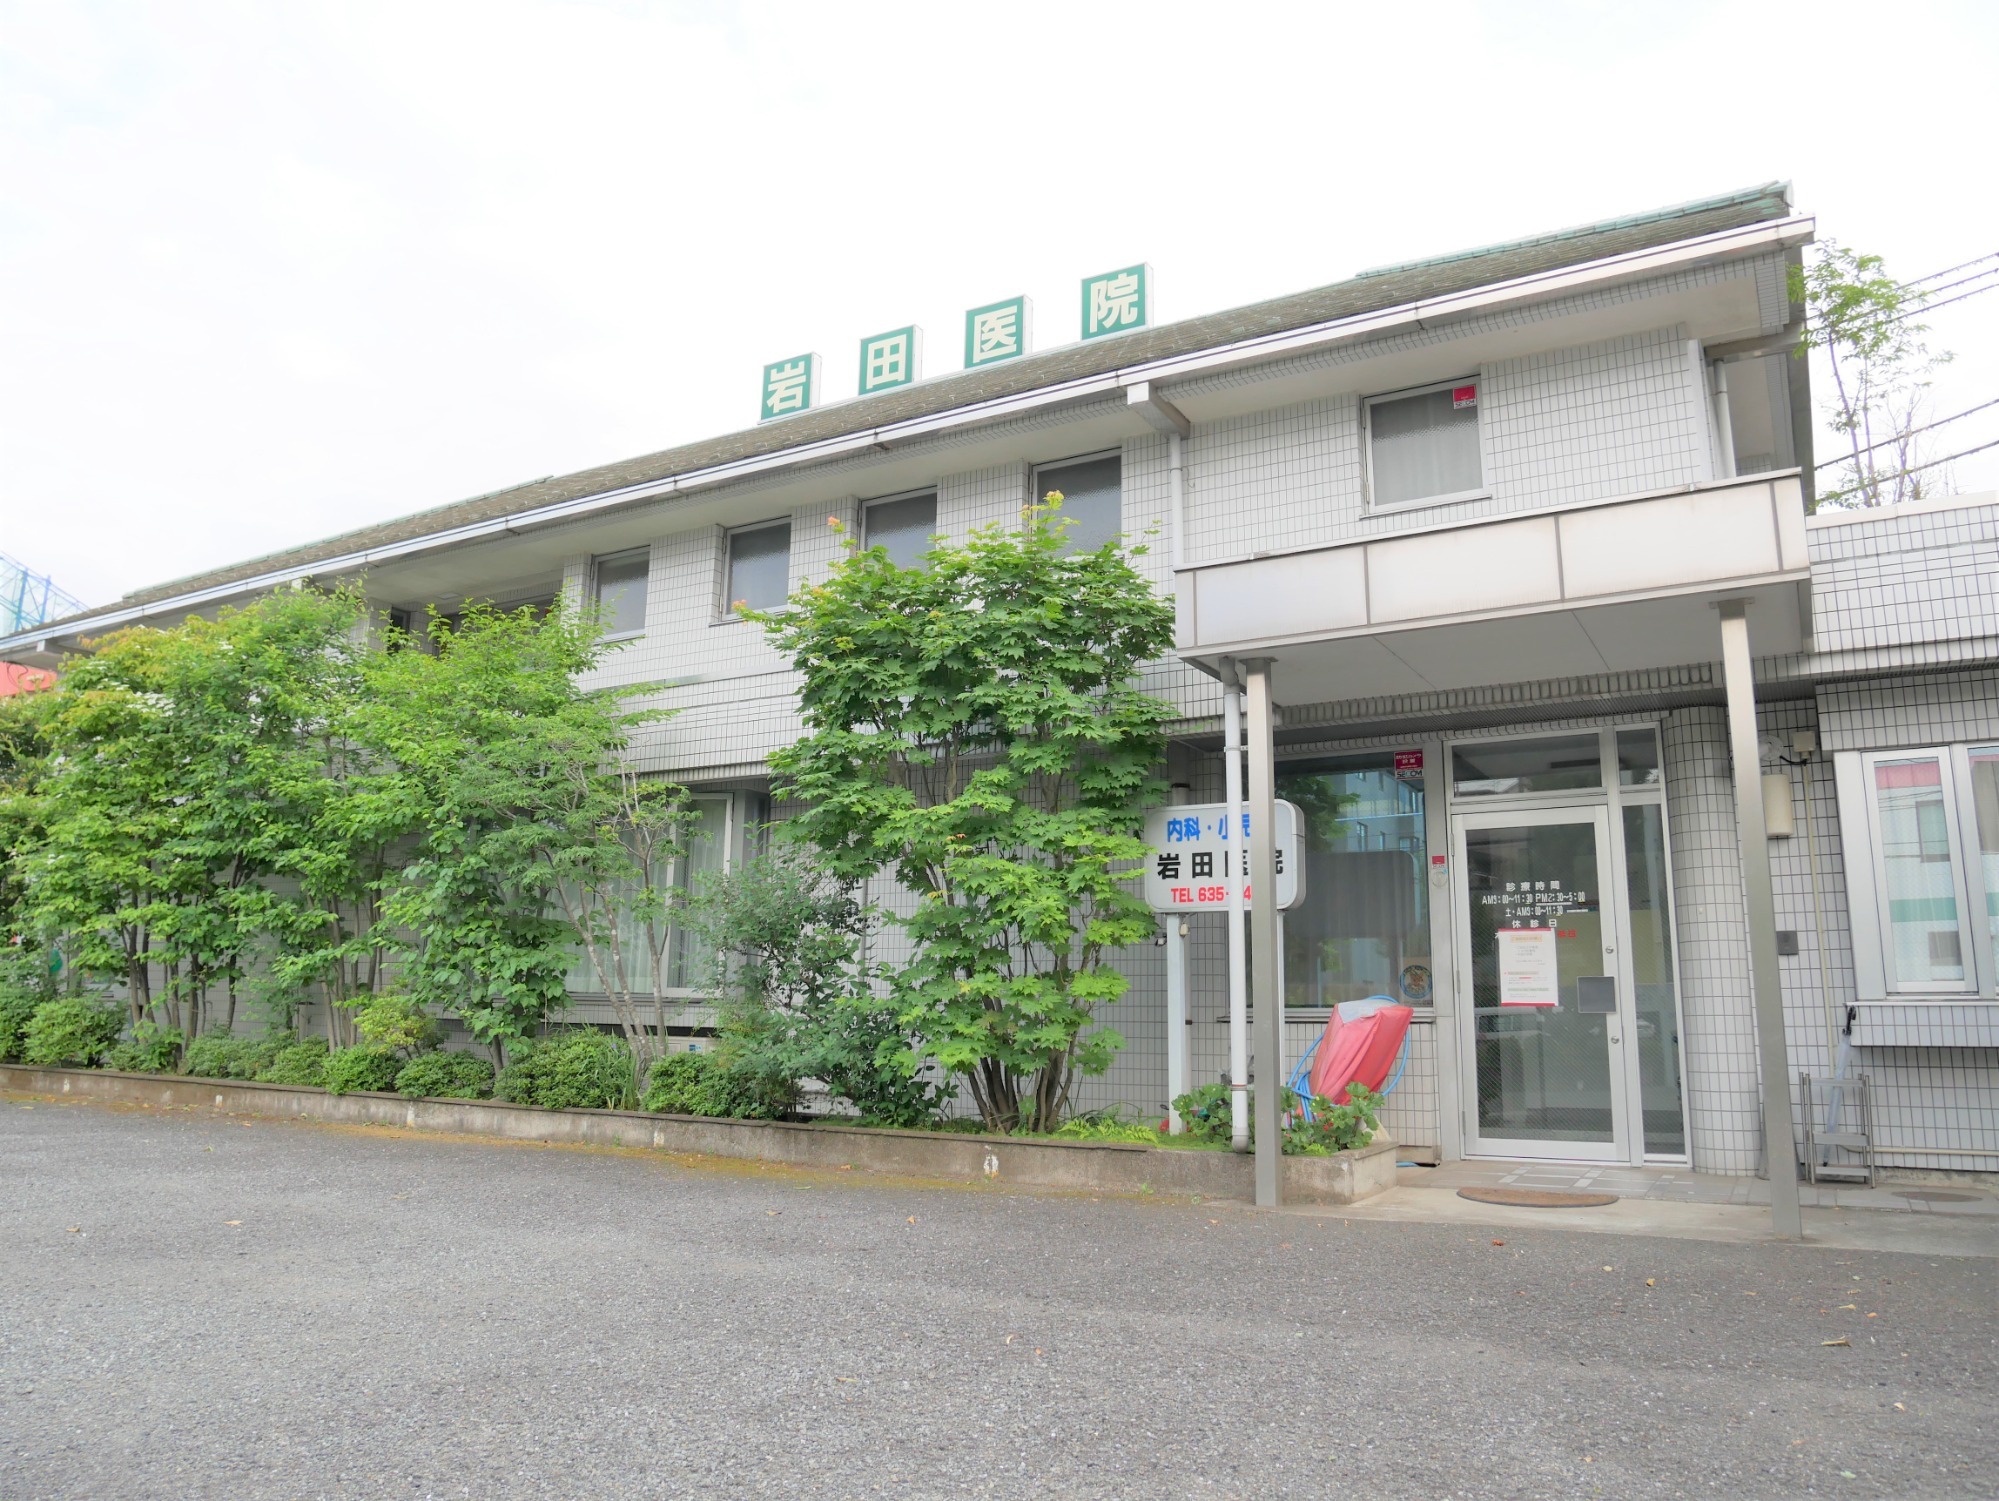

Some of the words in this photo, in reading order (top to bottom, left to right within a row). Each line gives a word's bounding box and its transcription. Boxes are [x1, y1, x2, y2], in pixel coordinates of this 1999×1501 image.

[766, 273, 1139, 414] 岩田医院
[1505, 880, 1560, 892] 診療時間
[1171, 887, 1194, 903] TEL
[1512, 919, 1557, 928] 休診日
